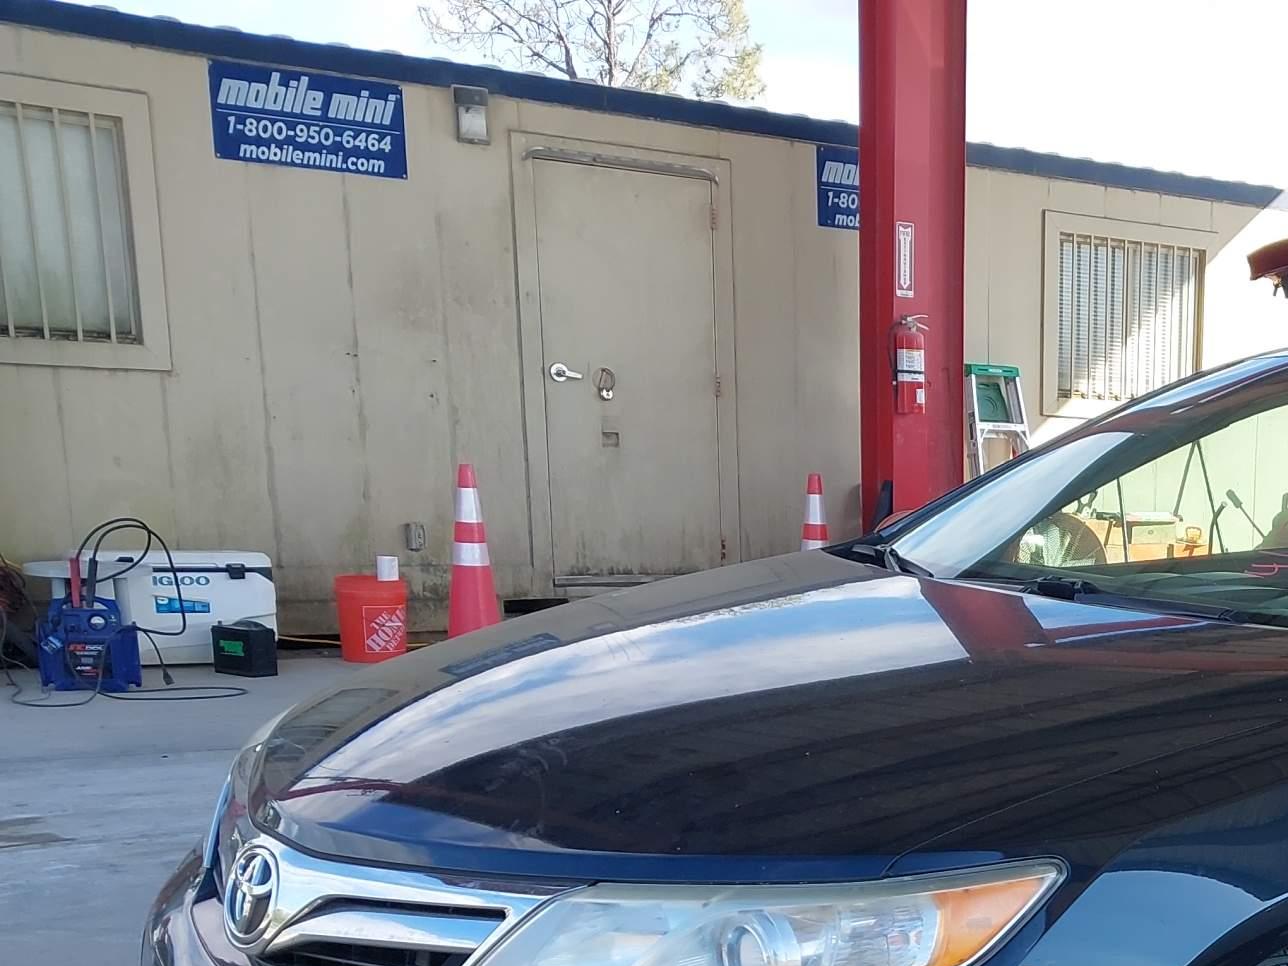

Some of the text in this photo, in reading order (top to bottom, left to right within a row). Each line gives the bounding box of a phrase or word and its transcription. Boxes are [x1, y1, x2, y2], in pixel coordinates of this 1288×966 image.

[217, 72, 397, 126] mobile mini
[226, 115, 392, 153] 1-800-950-6464
[238, 143, 385, 174] mobilemini.com
[151, 575, 211, 586] IGOO
